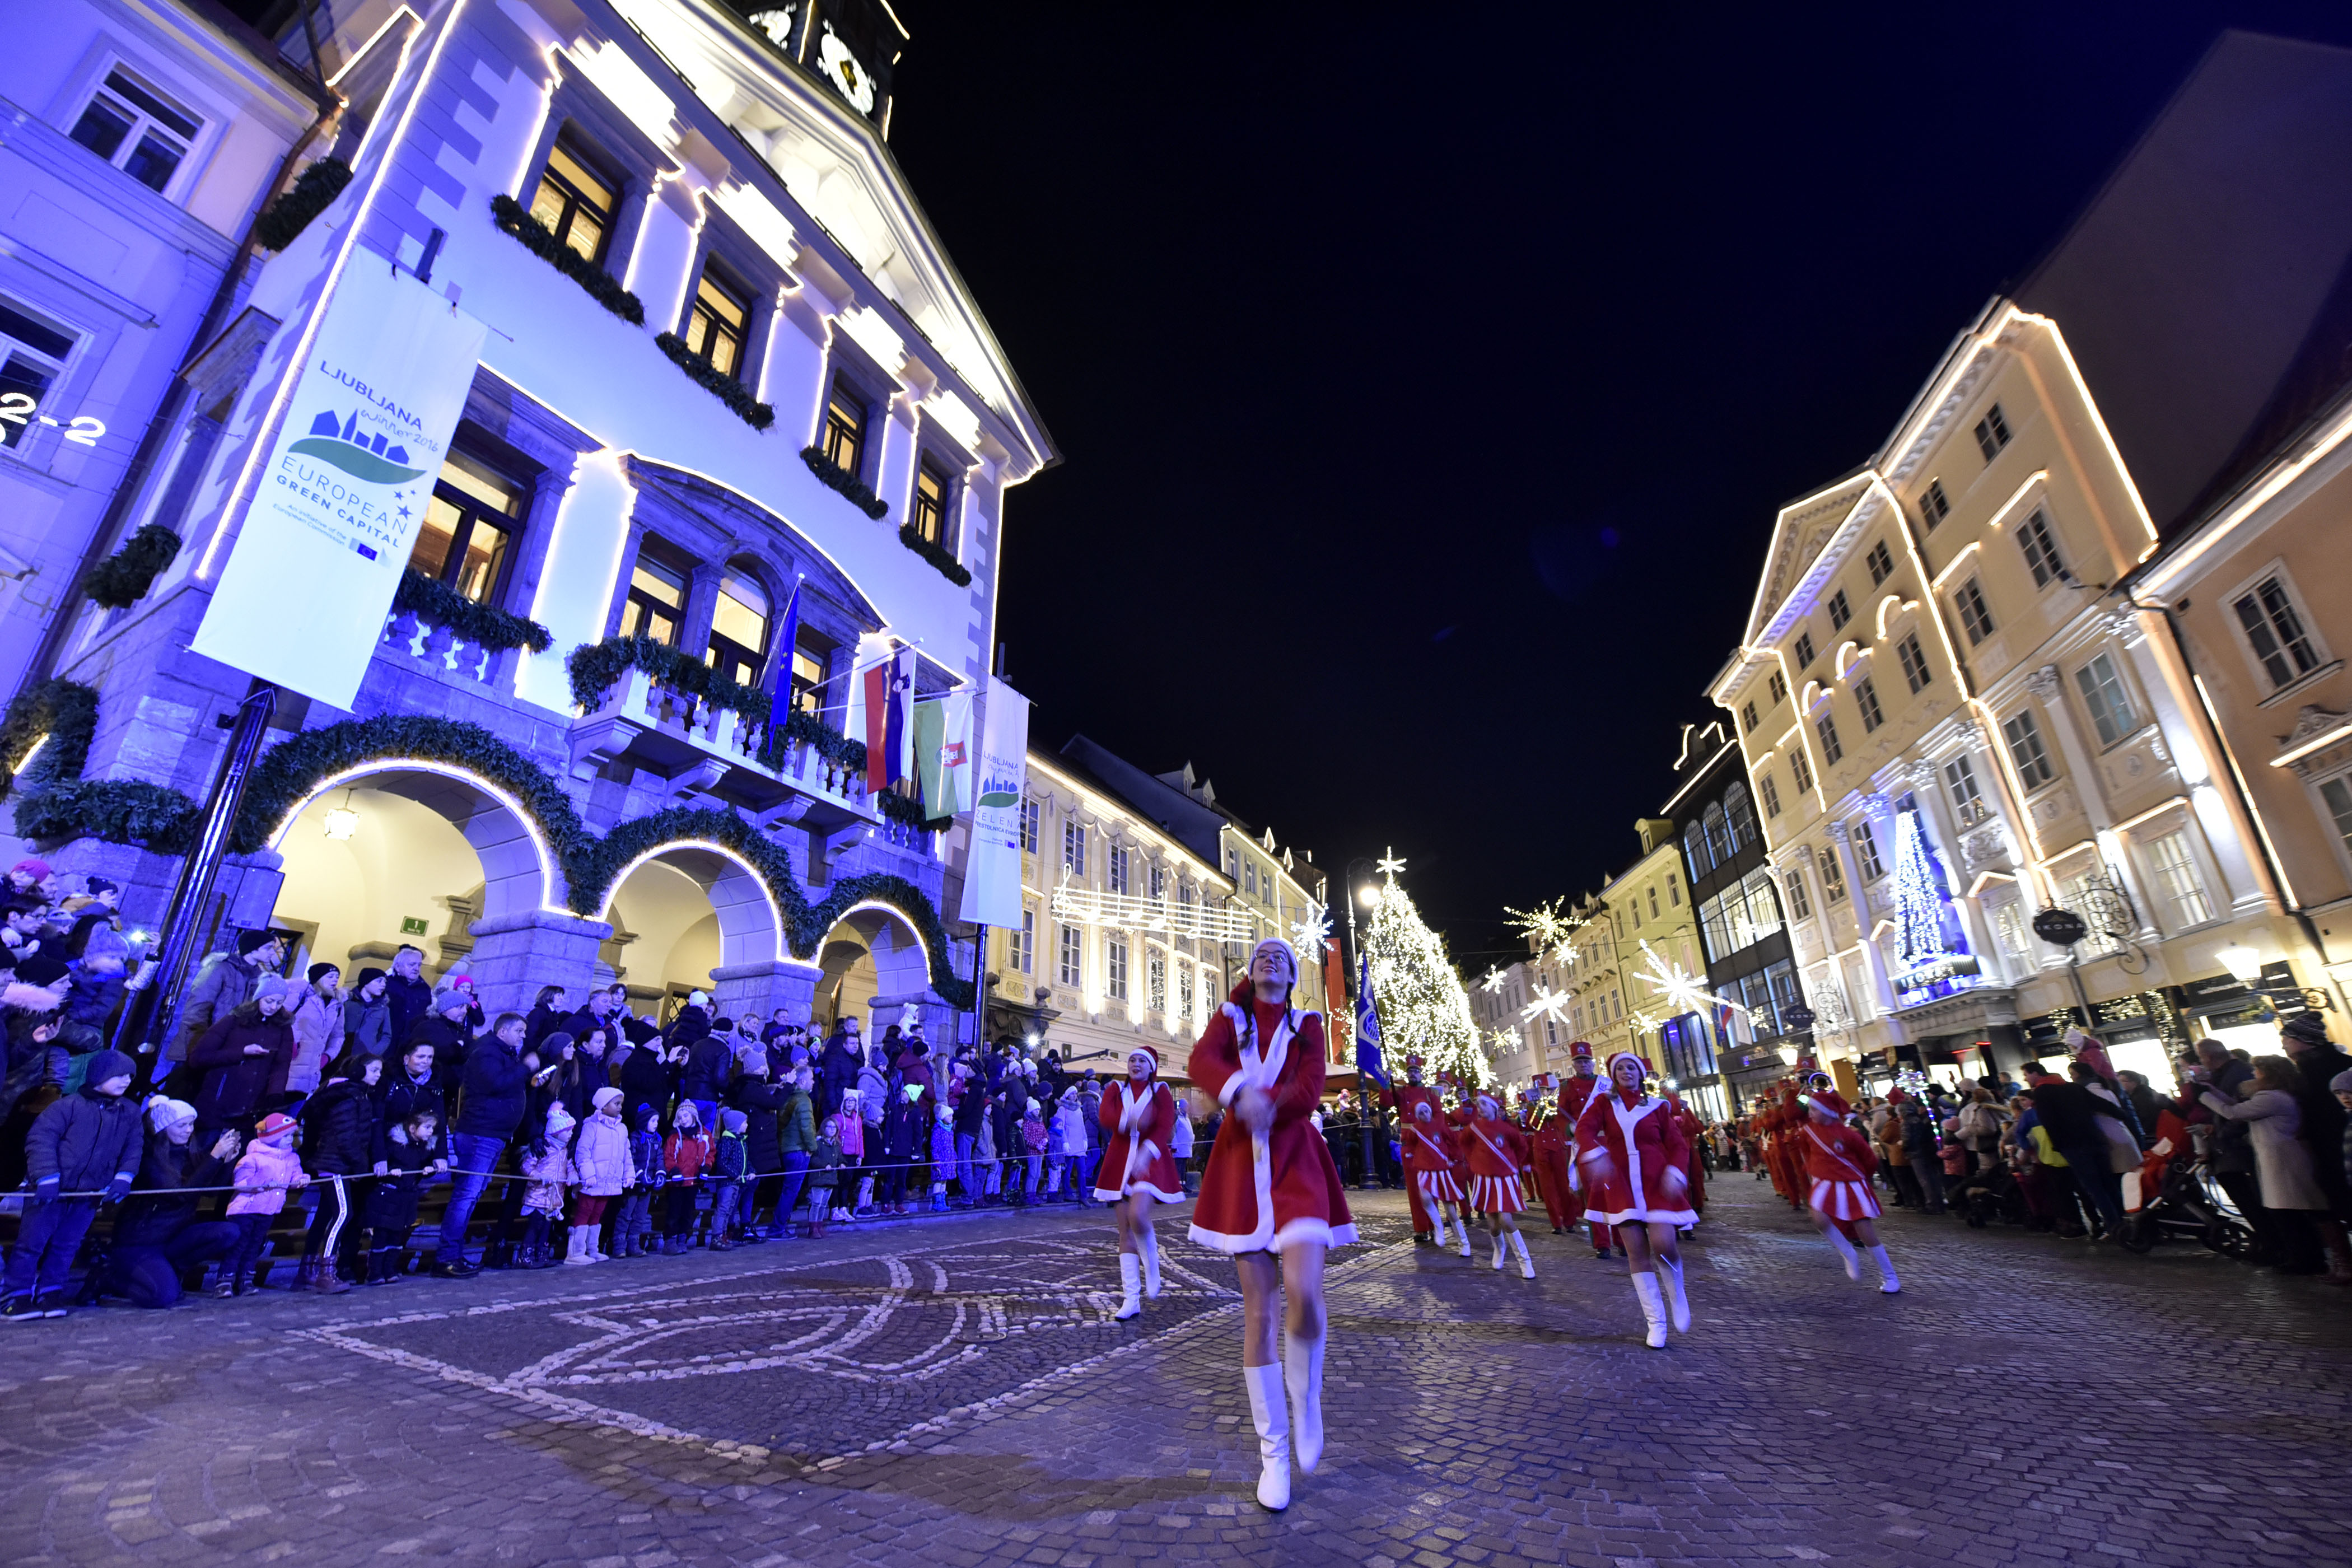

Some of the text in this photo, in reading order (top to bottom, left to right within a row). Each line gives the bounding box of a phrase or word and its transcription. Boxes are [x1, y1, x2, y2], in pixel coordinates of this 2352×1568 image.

[320, 360, 422, 431] LJUBLJANA
[360, 409, 439, 452] winner 2016
[277, 474, 399, 548] GREEN CAPITAL
[282, 456, 407, 535] EUROPEAN
[983, 750, 1018, 769] LJUBLJANA
[975, 820, 1005, 833] PRESTOLNICA
[414, 920, 419, 928] 1
